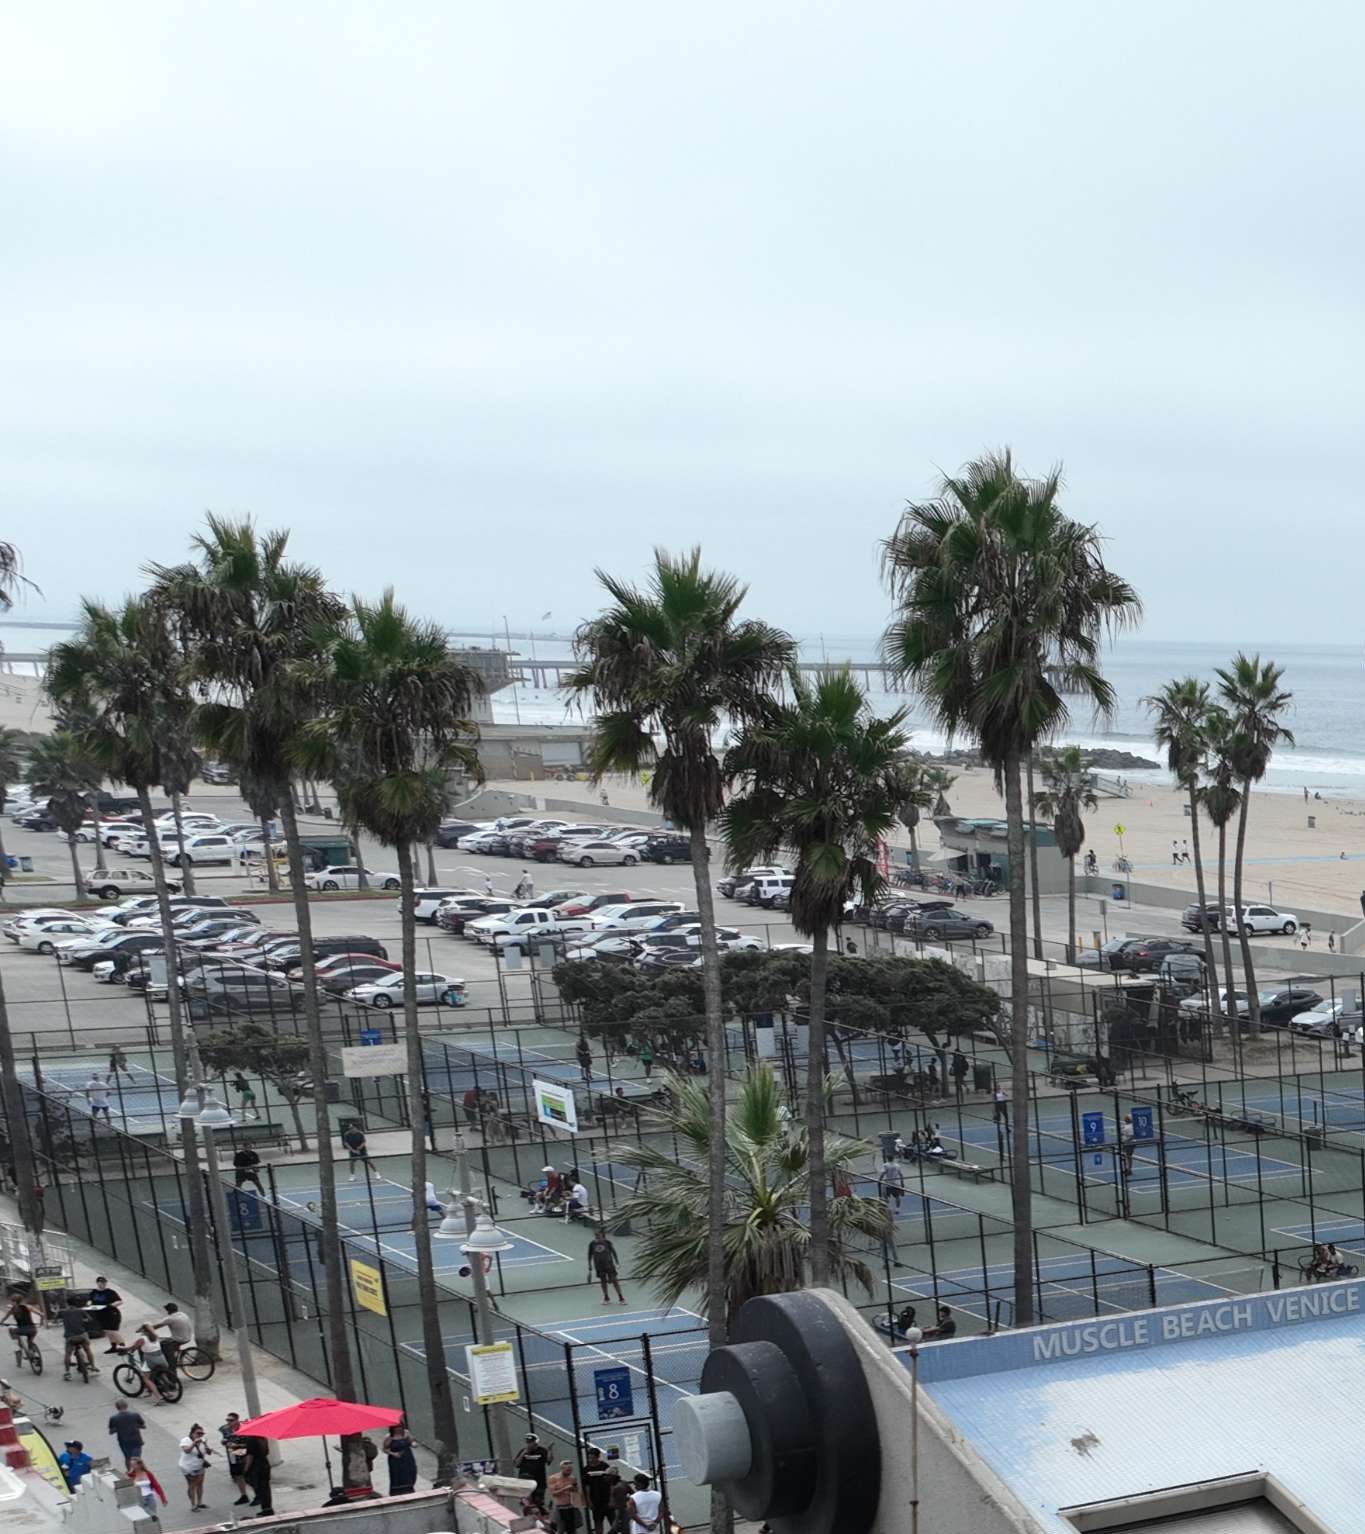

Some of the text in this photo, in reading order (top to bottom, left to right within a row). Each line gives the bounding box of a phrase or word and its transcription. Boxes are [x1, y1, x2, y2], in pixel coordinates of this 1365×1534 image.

[1090, 1122, 1097, 1133] 9
[1137, 1116, 1148, 1128] 10
[239, 1202, 249, 1216] 8
[1033, 1288, 1360, 1360] MUSCLE BEACH VENICE
[608, 1383, 620, 1400] 8
